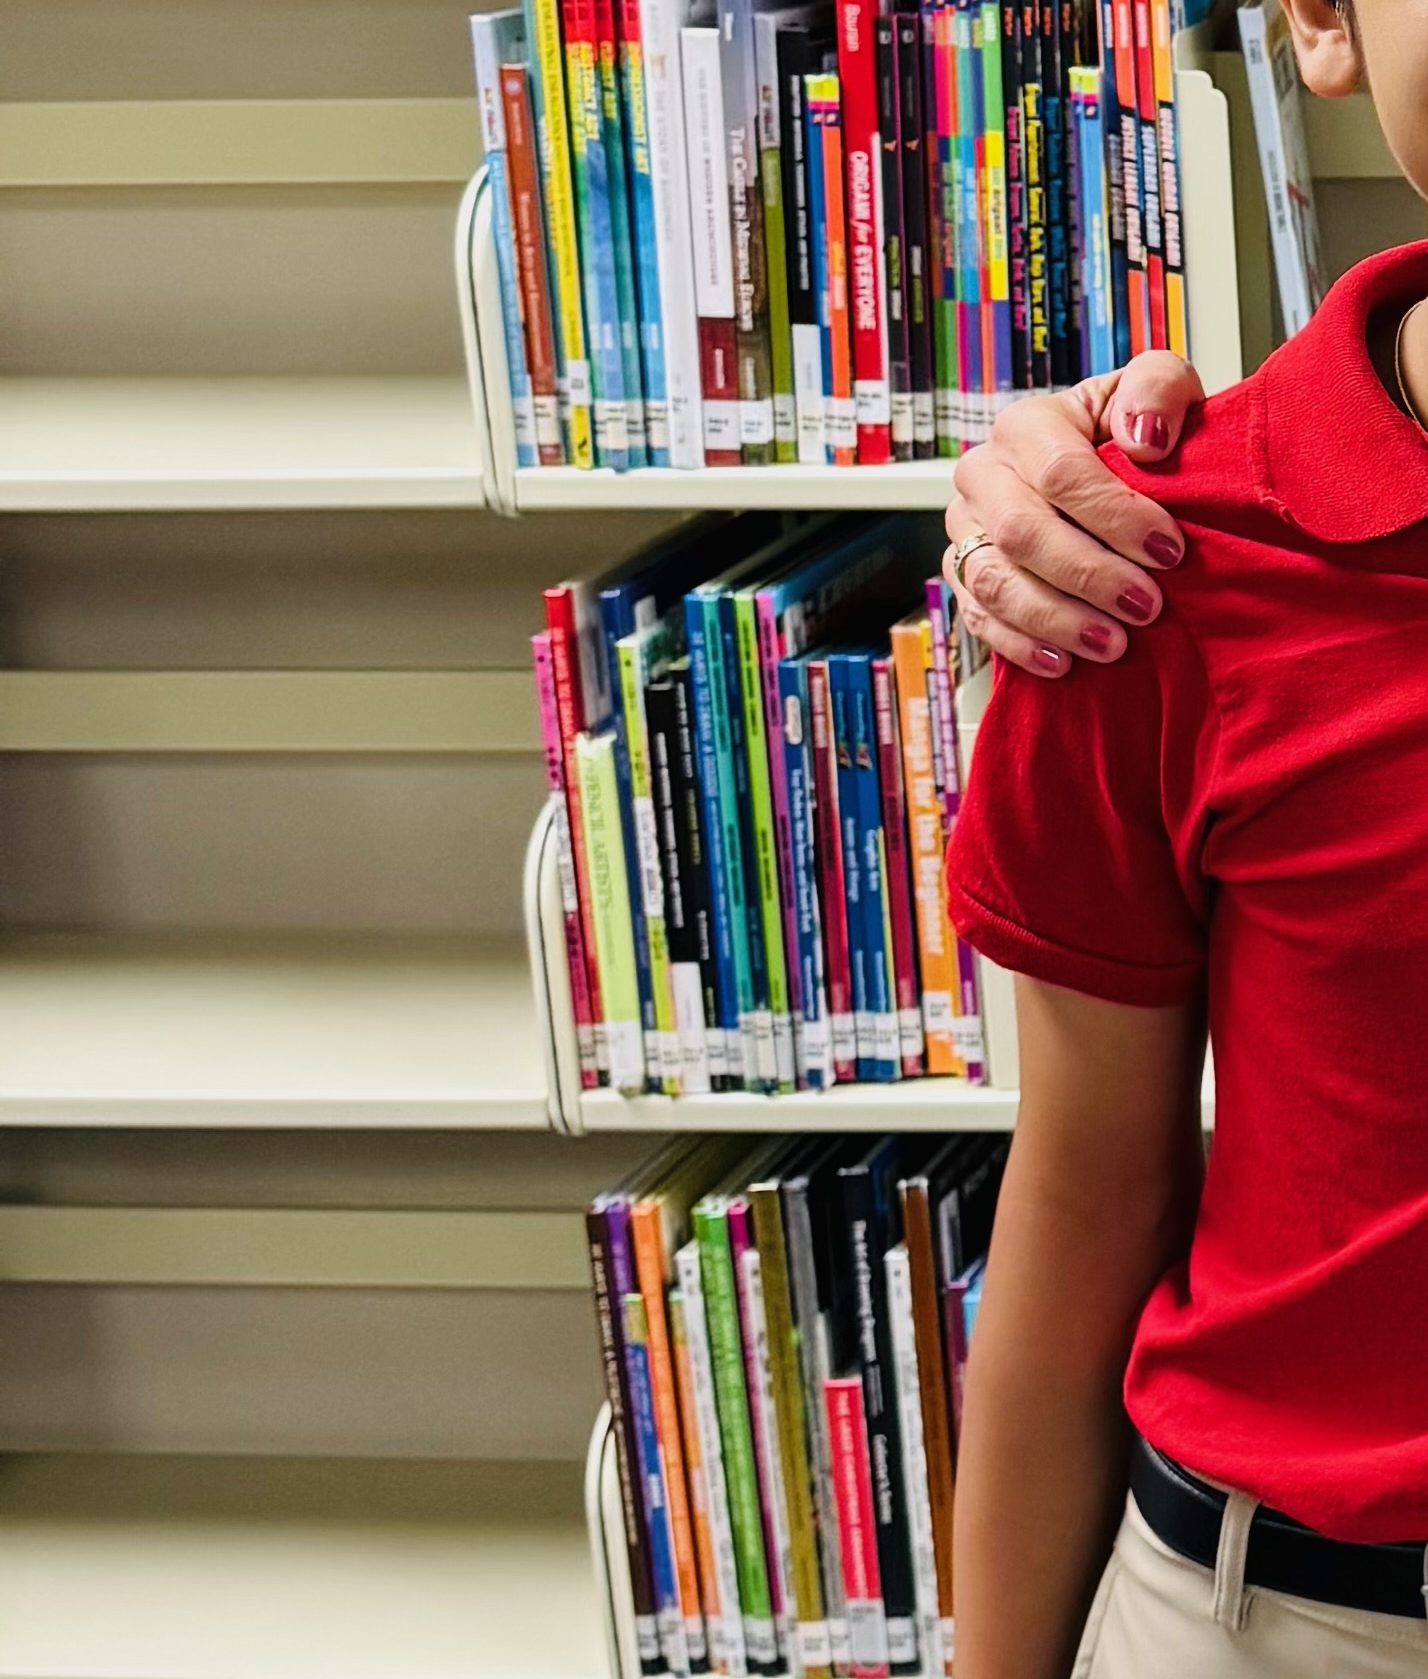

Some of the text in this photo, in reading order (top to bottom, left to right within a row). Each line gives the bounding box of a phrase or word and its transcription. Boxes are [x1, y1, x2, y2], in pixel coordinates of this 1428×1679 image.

[850, 151, 871, 220] ORIGAMI
[853, 245, 877, 331] EVERYONE
[913, 777, 936, 809] for
[916, 813, 938, 851] the
